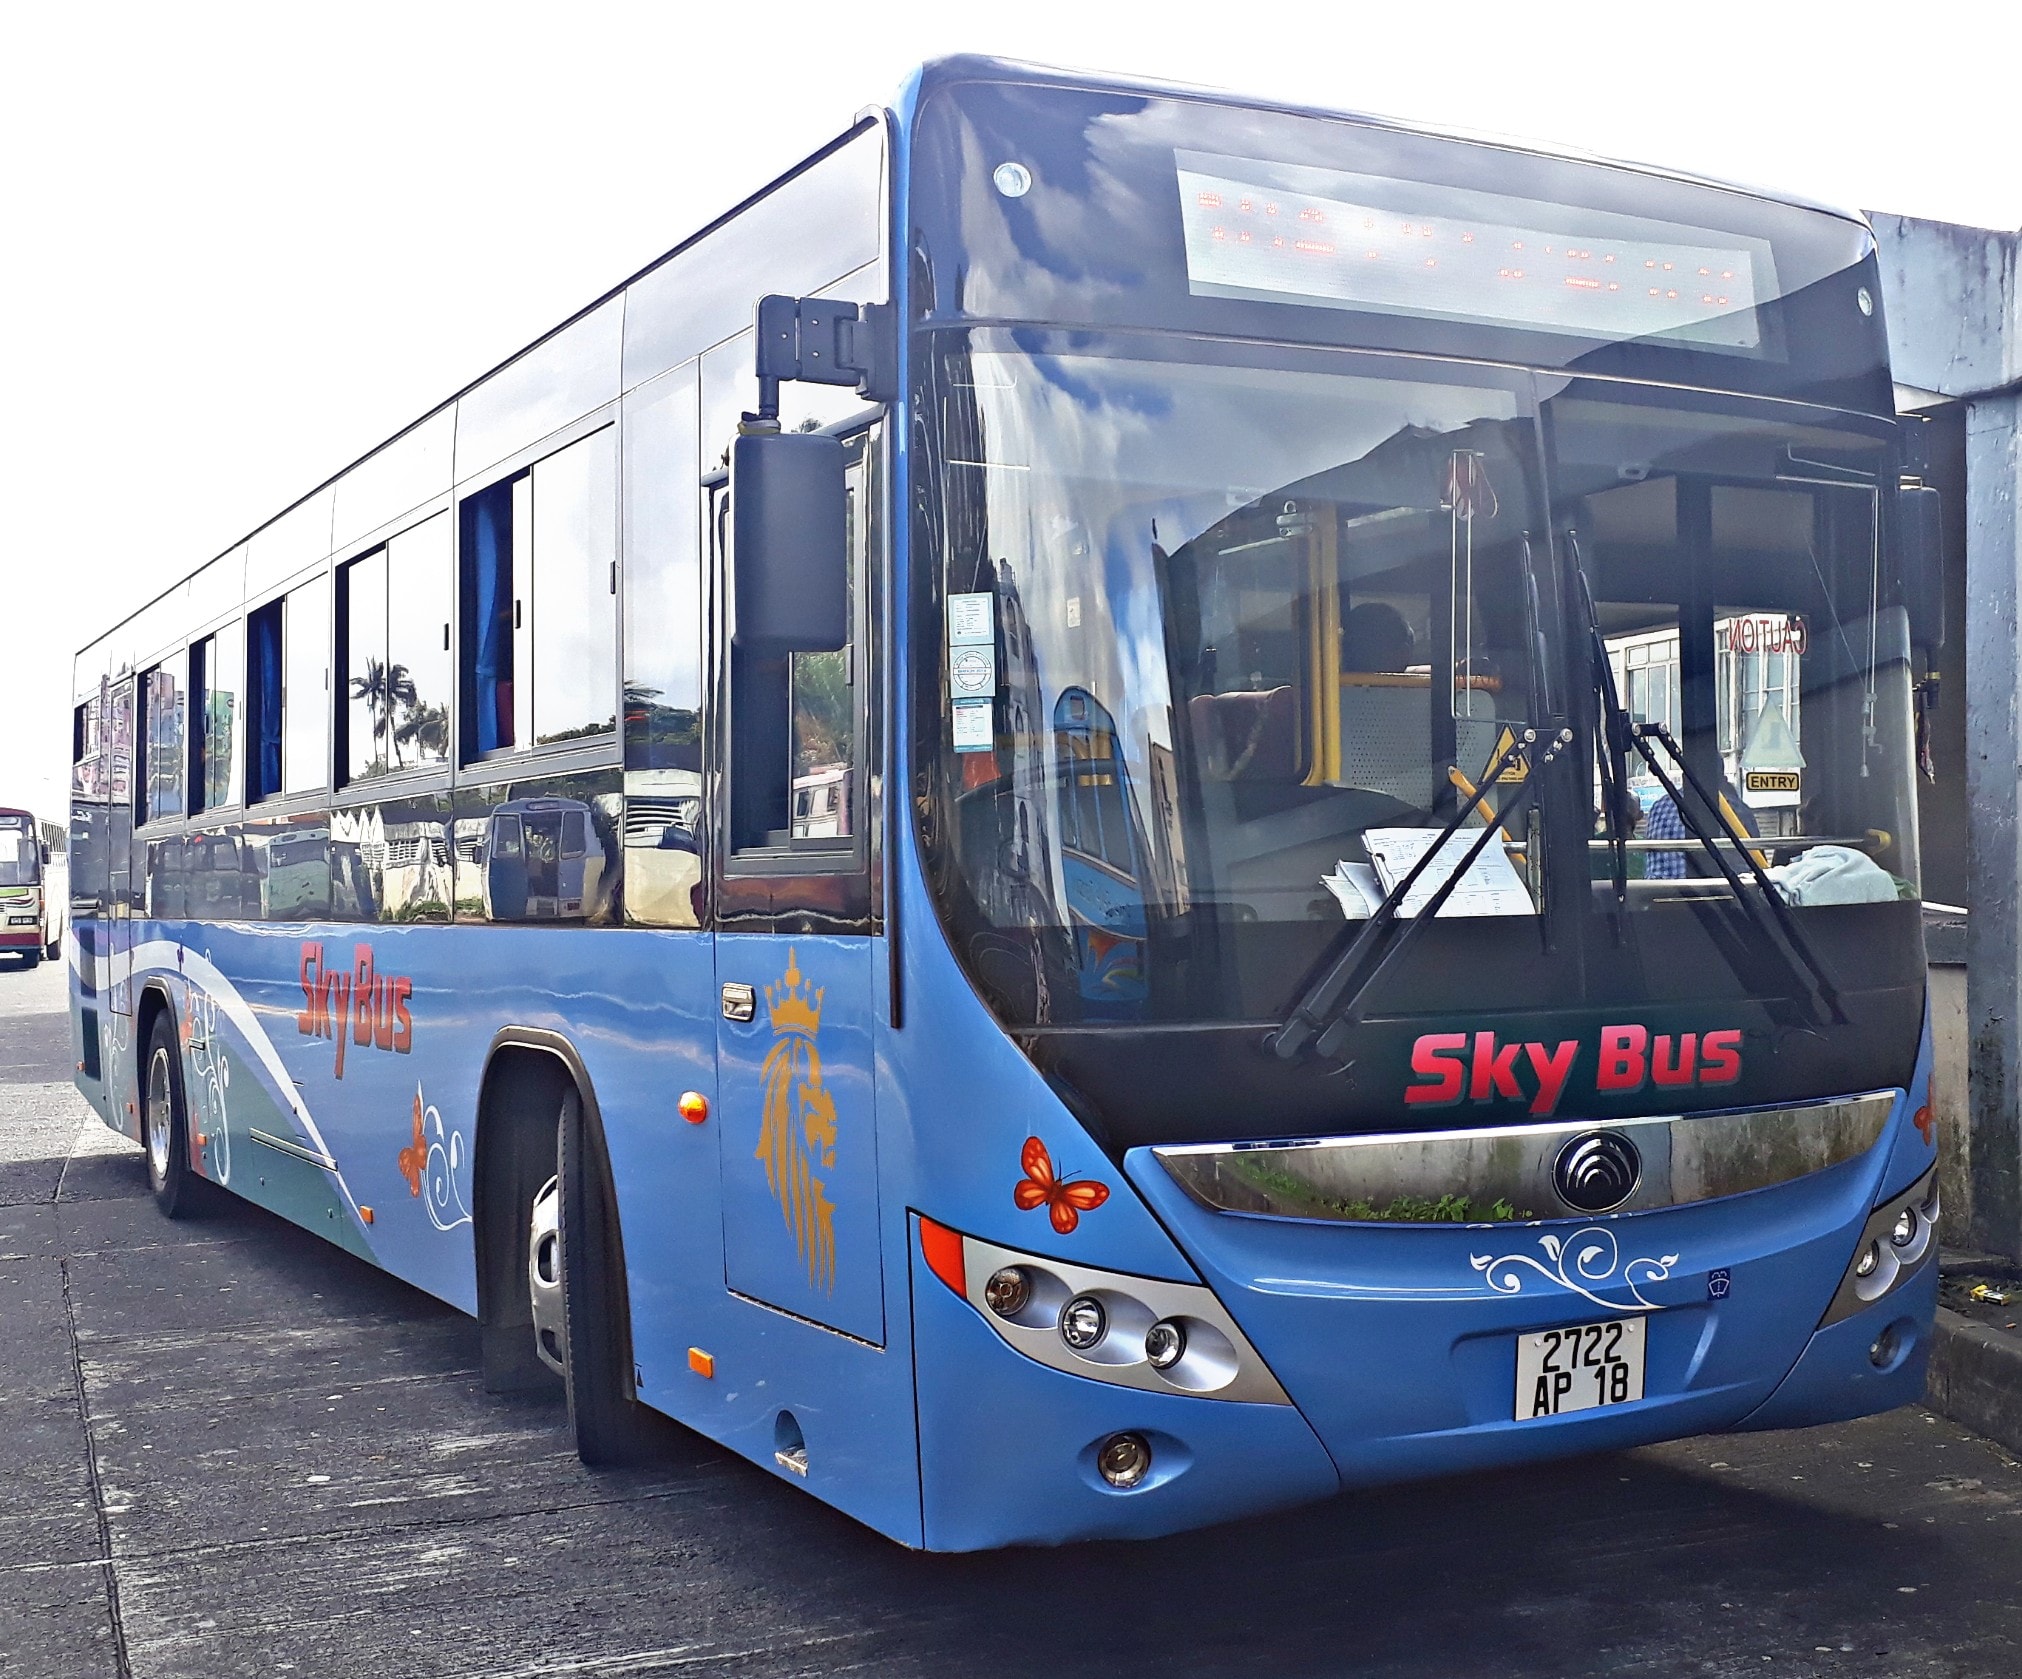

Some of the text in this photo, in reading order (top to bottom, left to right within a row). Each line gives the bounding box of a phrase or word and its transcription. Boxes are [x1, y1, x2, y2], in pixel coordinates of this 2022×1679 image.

[1750, 775, 1796, 789] ENTRY
[298, 941, 412, 1081] Sky Bus
[1404, 1024, 1742, 1114] Sky Bus
[1542, 1322, 1623, 1374] 2722
[1532, 1361, 1629, 1417] AP 18
